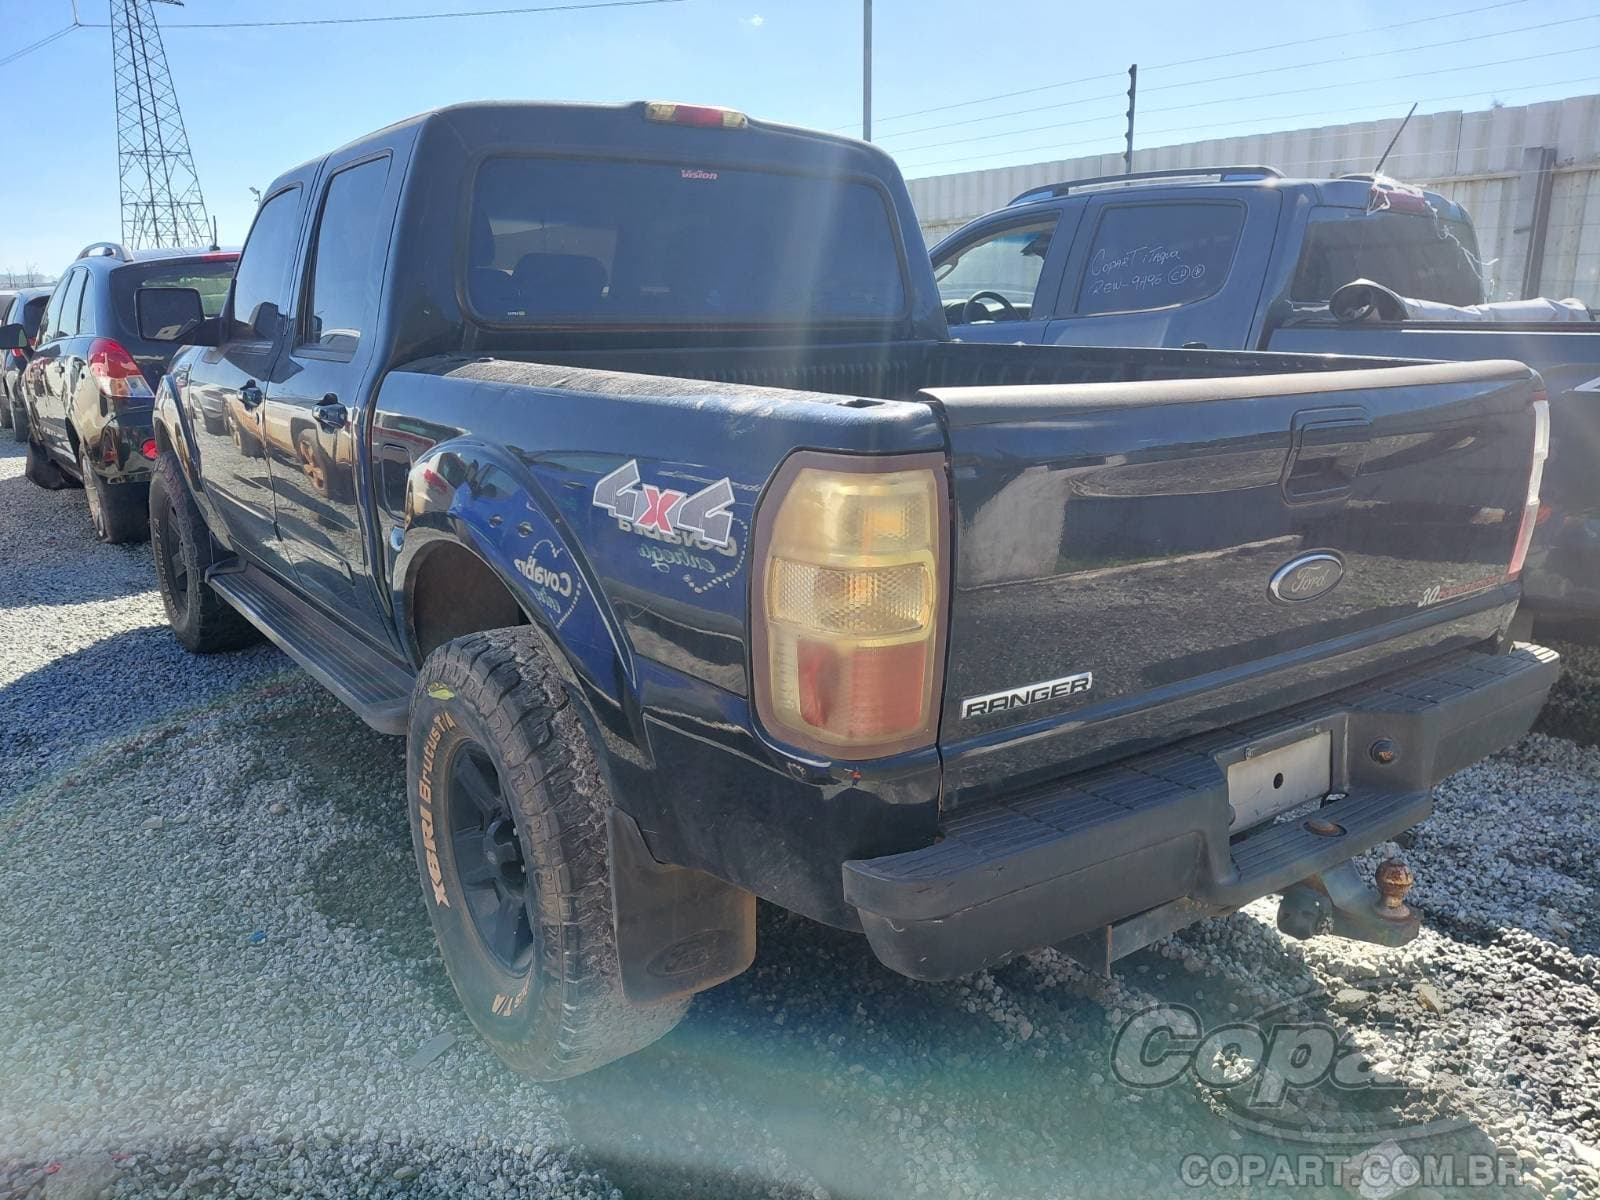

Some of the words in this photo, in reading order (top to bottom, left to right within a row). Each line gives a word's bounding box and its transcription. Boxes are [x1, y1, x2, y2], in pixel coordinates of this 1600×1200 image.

[1291, 565, 1330, 592] Ford
[966, 677, 1089, 717] RANGER
[420, 805, 451, 908] XBRI
